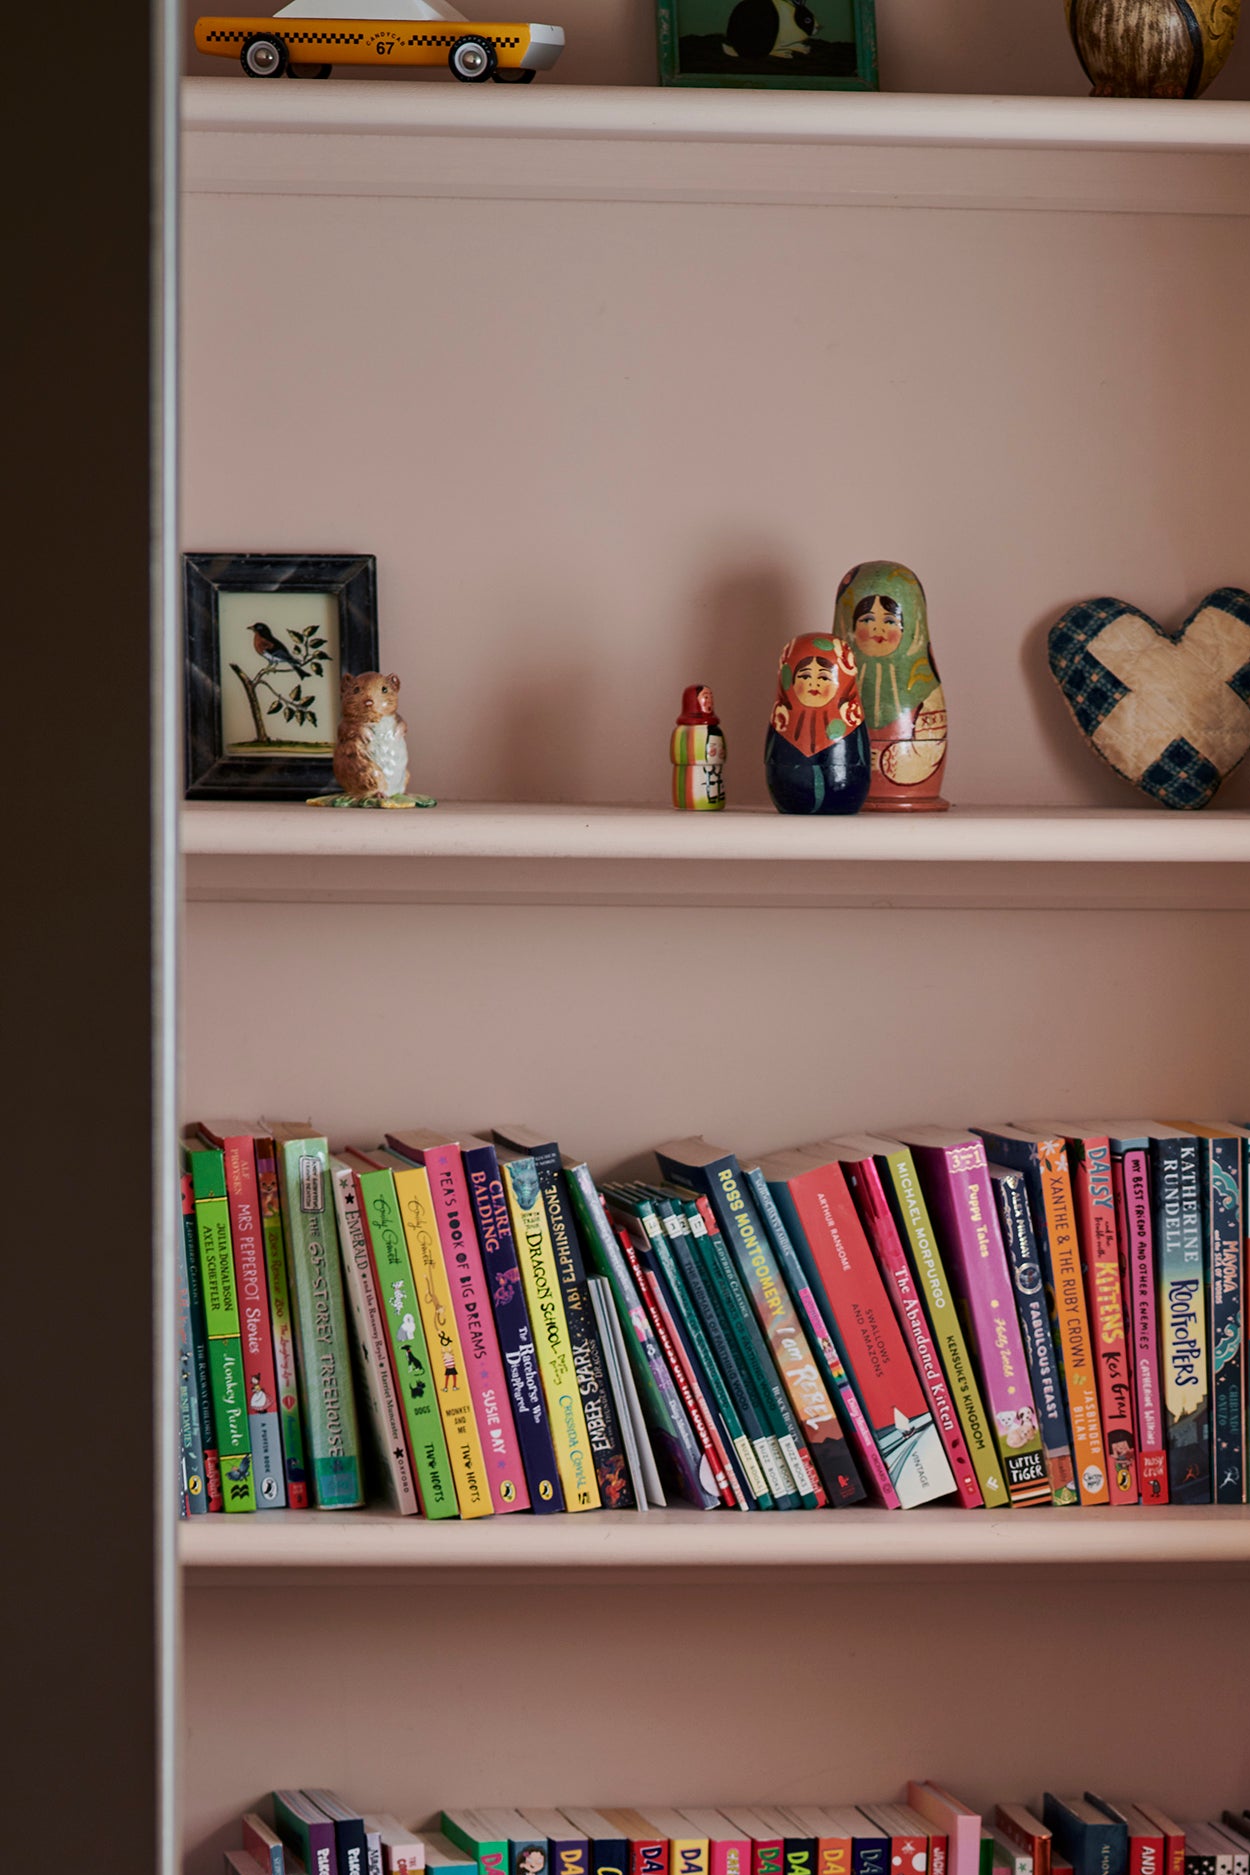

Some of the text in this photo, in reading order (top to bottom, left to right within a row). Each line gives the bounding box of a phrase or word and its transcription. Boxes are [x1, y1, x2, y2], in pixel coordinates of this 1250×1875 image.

[365, 32, 406, 46] CANDYCAB
[376, 41, 393, 55] 67
[308, 1217, 321, 1238] THE
[345, 1209, 369, 1270] EMERALD
[470, 1170, 500, 1253] BALDING
[488, 1180, 512, 1240] CLARE
[544, 1184, 576, 1283] ELPHINSTONE
[817, 1193, 851, 1271] ARTHUR RANSOME
[897, 1161, 945, 1309] MICHAEL MORPURGO
[968, 1184, 989, 1258] Puppy Tales
[1016, 1219, 1031, 1259] MILWAY
[1131, 1159, 1148, 1296] MY BEST AND OTHER
[1163, 1160, 1181, 1253] RUNDELL
[1180, 1147, 1199, 1263] KATHERINE
[203, 1226, 220, 1311] AXEL SCHEFFLER
[216, 1222, 233, 1311] JULIA DONALDSON
[440, 1171, 487, 1359] PEA'S BOOK OF BIG DREAMS
[525, 1231, 552, 1300] DRAGON
[718, 1169, 786, 1317] ROSS MONTGOMERY
[1049, 1176, 1086, 1368] XANTHE & THE RUBY CROWN
[1088, 1146, 1124, 1344] DAISY KITTENS
[1222, 1240, 1239, 1293] MAYOWA
[238, 1204, 262, 1354] MRS PEPPERPOT Stories
[309, 1242, 334, 1344] 65-STOREY
[566, 1288, 583, 1311] ABI
[851, 1303, 883, 1378] AND AMAZONS
[865, 1309, 890, 1363] SWALLOWS
[894, 1265, 955, 1431] The Abandoned Kitten
[994, 1318, 1008, 1348] Holly
[1029, 1302, 1058, 1419] FABULOUS FEAST
[1168, 1278, 1201, 1387] ROOFTOPPERS
[223, 1353, 244, 1447] Monkey Puzzle
[320, 1353, 345, 1457] TREEHOUSE
[380, 1371, 398, 1440] Harriet Muncaster
[505, 1351, 529, 1413] Disappeared
[519, 1342, 539, 1403] Racehorse
[572, 1338, 615, 1452] EMBER SPARK
[780, 1338, 834, 1431] am REBEL
[946, 1335, 986, 1450] KENSUKE'S KINGDOM
[1102, 1351, 1130, 1420] Kes Gray
[414, 1405, 432, 1416] DOGS
[445, 1406, 471, 1417] MONKEY
[454, 1416, 466, 1425] AND
[458, 1426, 467, 1434] ME
[482, 1389, 506, 1454] SUSIE DAY
[559, 1395, 579, 1448] CRESSIDA
[1073, 1406, 1087, 1442] BILAN
[1083, 1390, 1099, 1454] JASBINDER
[398, 1459, 409, 1493] OXFORD
[430, 1471, 445, 1503] HOOTS
[466, 1471, 480, 1504] HOOTS
[911, 1451, 930, 1488] VINTAGE
[1173, 1849, 1184, 1869] The
